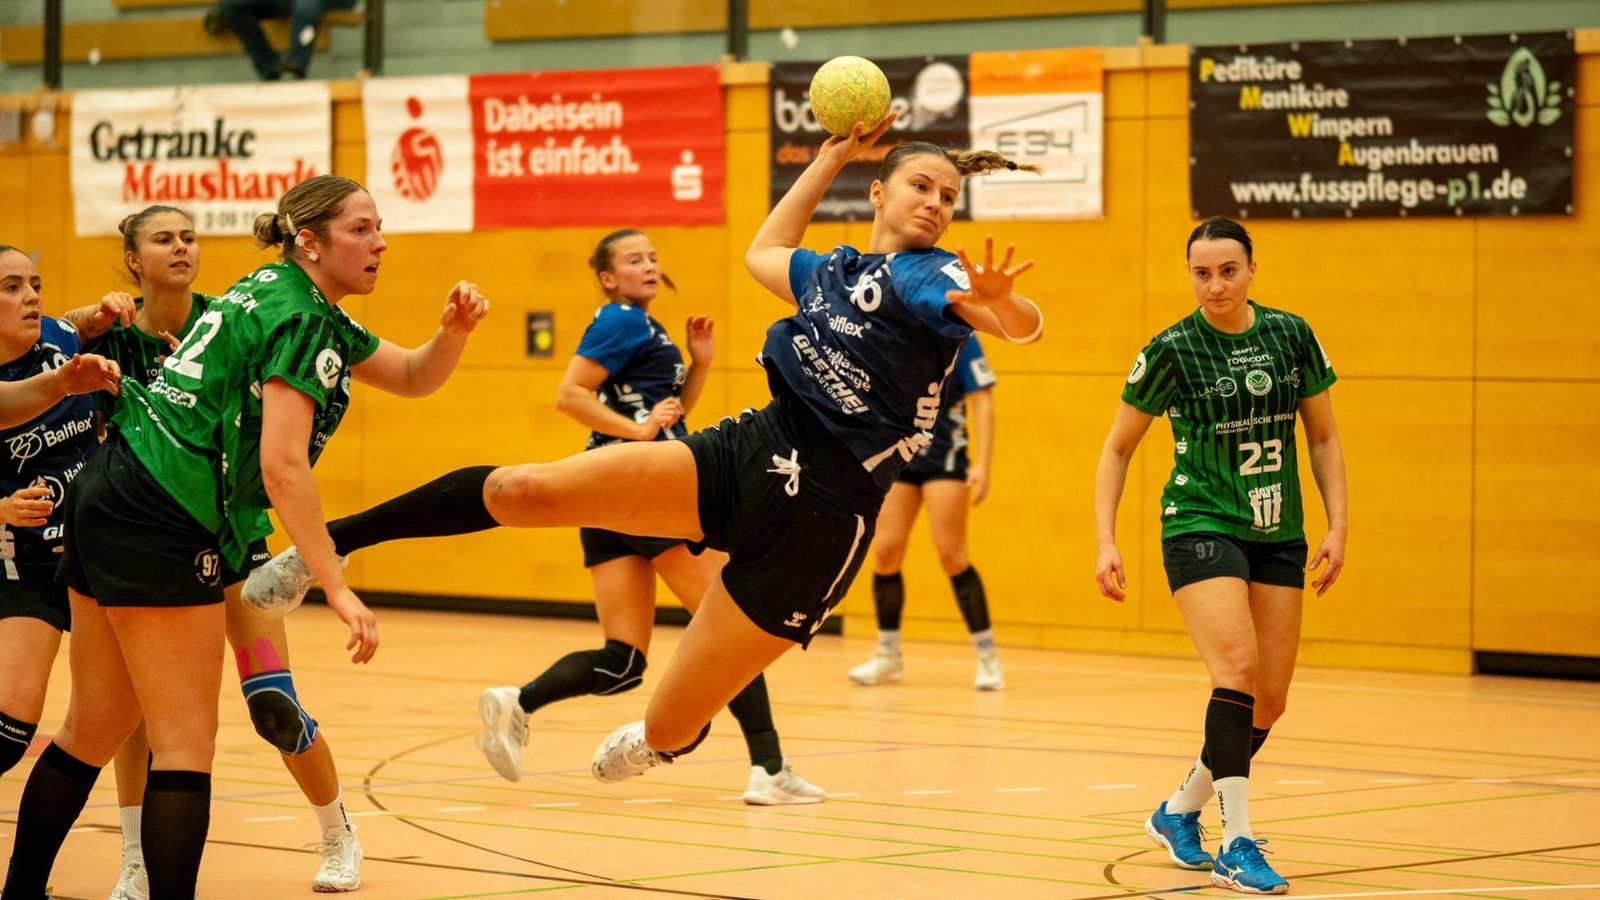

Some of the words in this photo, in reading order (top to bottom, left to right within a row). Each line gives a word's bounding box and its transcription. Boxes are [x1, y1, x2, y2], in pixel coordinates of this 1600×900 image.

[1200, 57, 1302, 83] Pediküre
[484, 93, 624, 133] Dabeisein
[1240, 85, 1349, 110] Maniküre
[1288, 114, 1393, 141] Wimpern
[487, 140, 524, 178] ist
[529, 136, 639, 176] einfach.
[1338, 139, 1499, 170] Augenbrauen
[1231, 168, 1527, 208] www.fusspflege-p1.de
[825, 312, 865, 339] alflex
[164, 311, 222, 379] 2
[43, 417, 93, 448] Balflex
[1239, 438, 1282, 476] 23
[202, 554, 219, 577] 97
[1195, 542, 1215, 559] 97
